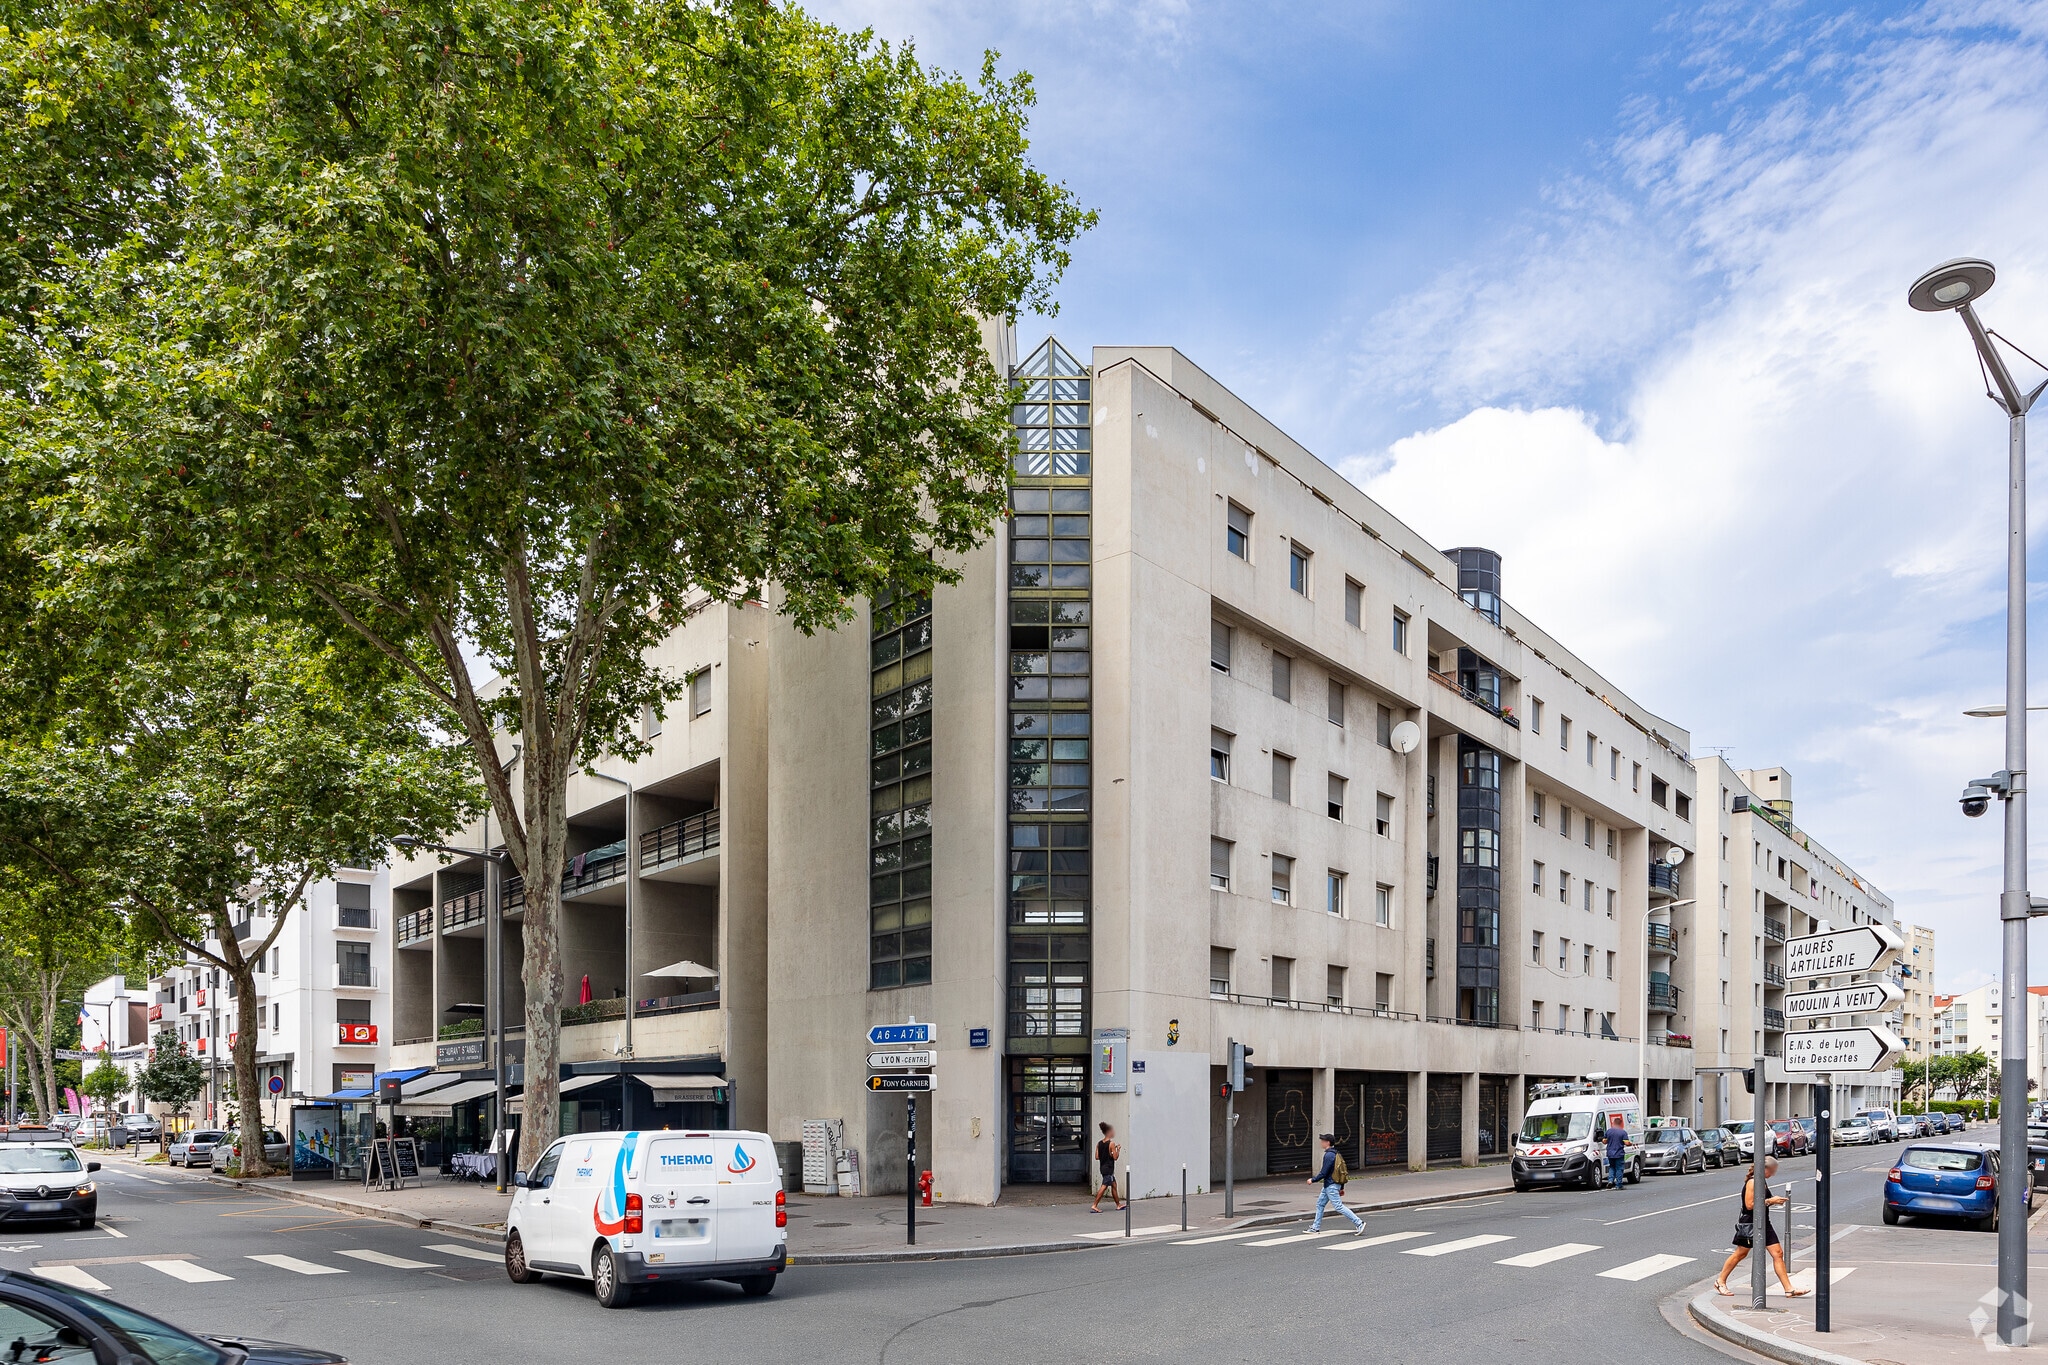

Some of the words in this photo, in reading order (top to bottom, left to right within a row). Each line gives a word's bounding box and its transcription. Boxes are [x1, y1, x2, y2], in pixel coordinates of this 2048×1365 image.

[1790, 939, 1834, 957] JAURÈS
[1790, 953, 1855, 973] ARTILLERIE
[1789, 996, 1830, 1013] MOULIN
[1833, 993, 1840, 1008] À
[1846, 991, 1875, 1007] VENT
[1789, 1040, 1814, 1050] E.N.S.
[1819, 1039, 1830, 1049] de
[1834, 1039, 1855, 1050] Lyon
[1789, 1055, 1806, 1064] site
[1811, 1053, 1859, 1064] Descartes
[882, 1079, 899, 1088] TONY
[900, 1079, 929, 1088] GARNIER
[660, 1154, 713, 1166] THERMO
[576, 1168, 593, 1177] THERMO
